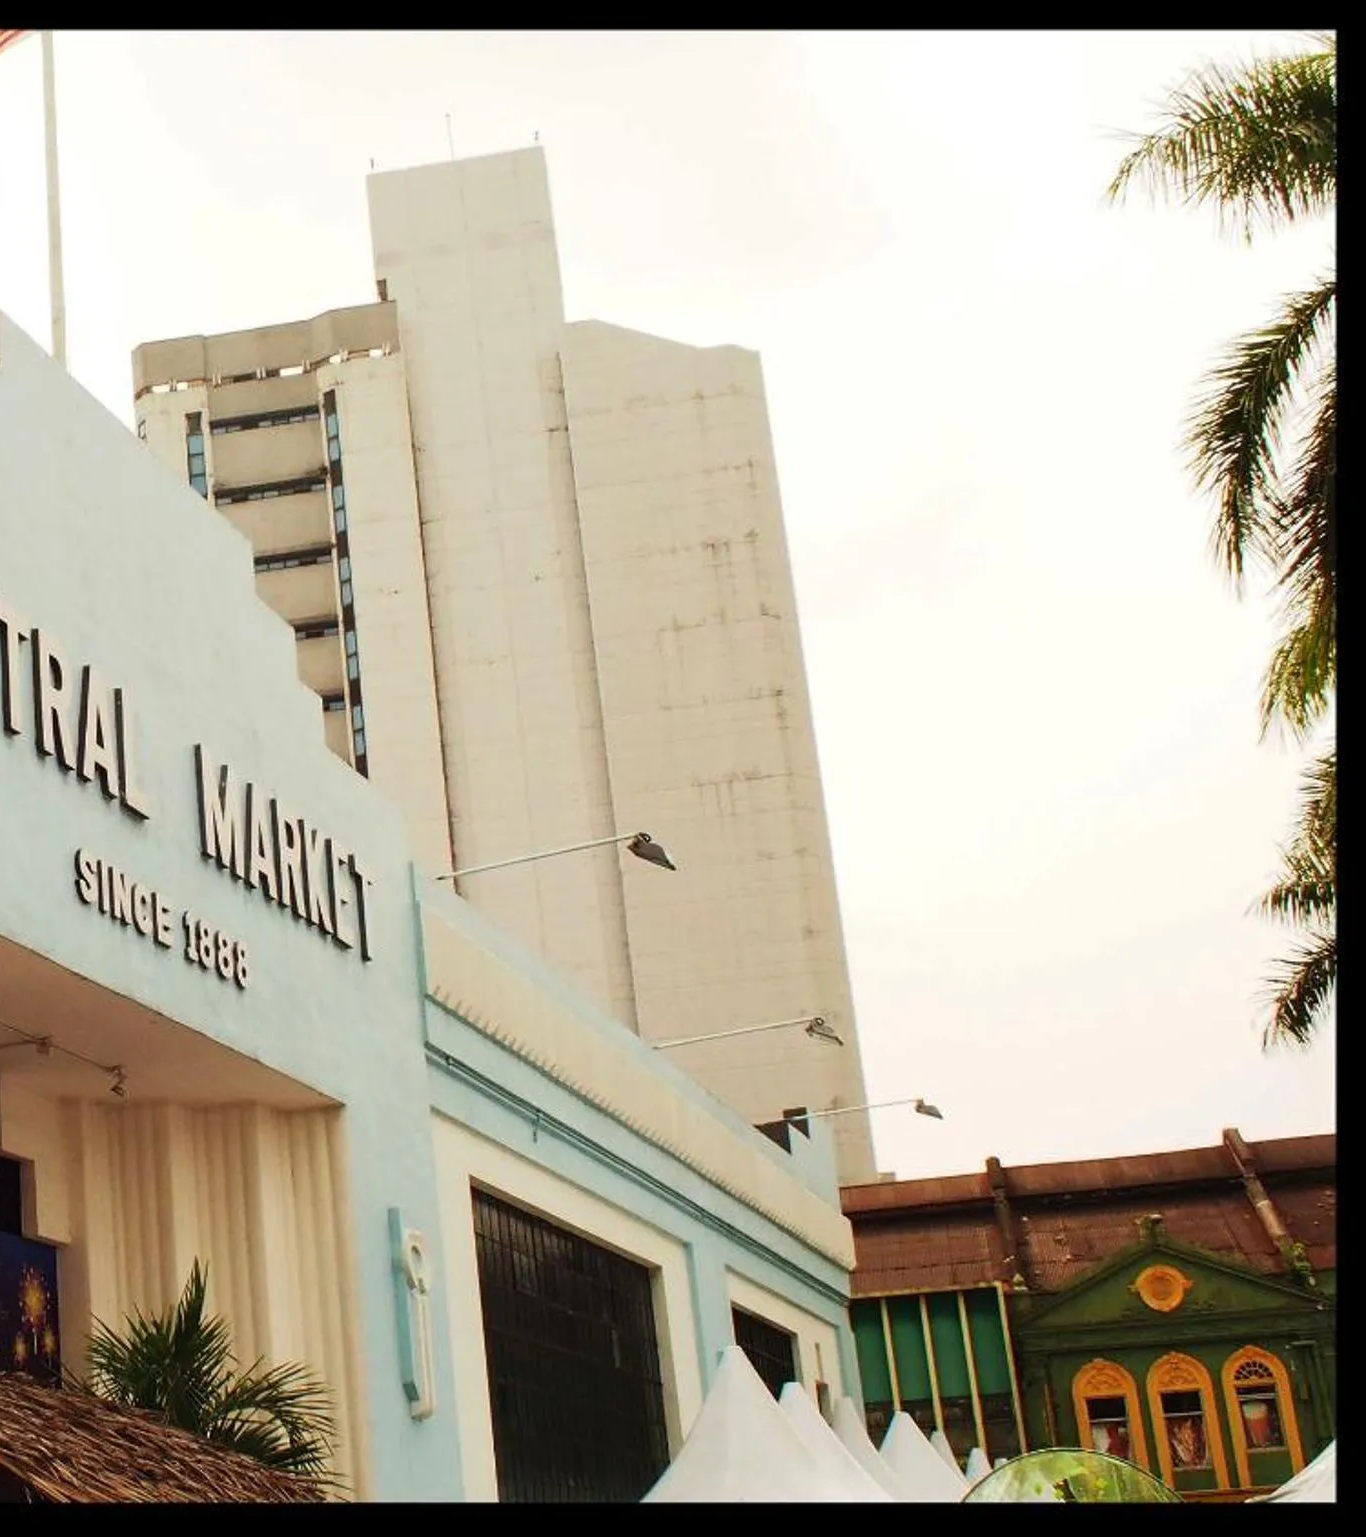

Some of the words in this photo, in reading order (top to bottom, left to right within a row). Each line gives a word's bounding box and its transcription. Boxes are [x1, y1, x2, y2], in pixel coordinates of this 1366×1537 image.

[73, 847, 173, 950] SINCE
[181, 909, 251, 989] 1888
[193, 742, 373, 962] MARKET
